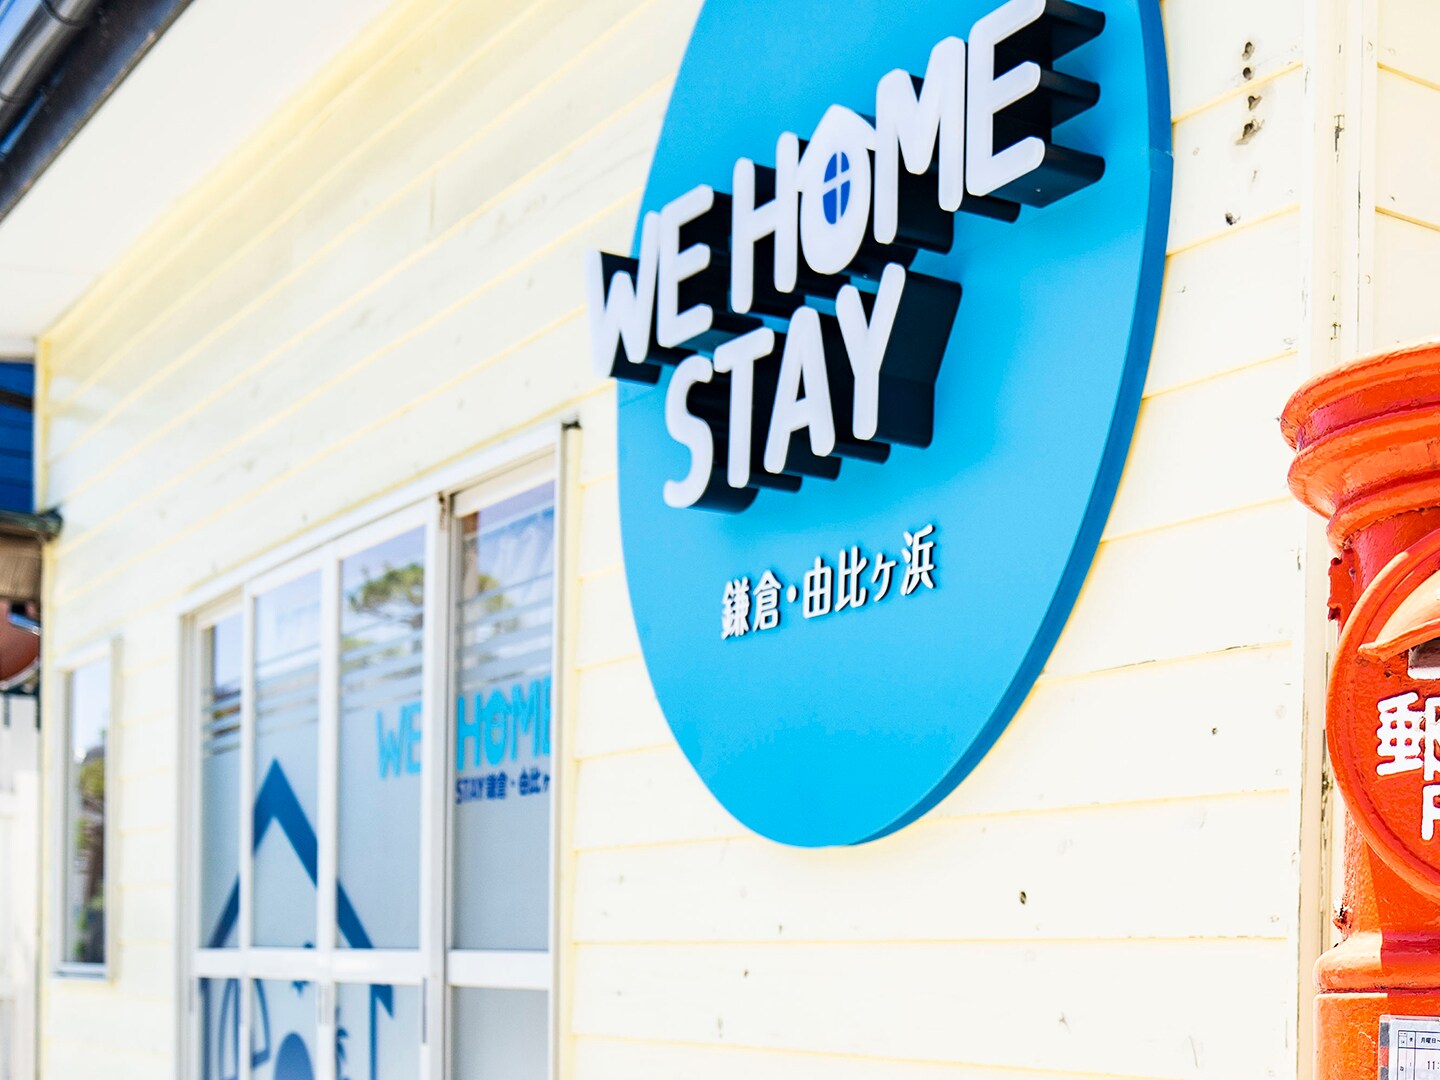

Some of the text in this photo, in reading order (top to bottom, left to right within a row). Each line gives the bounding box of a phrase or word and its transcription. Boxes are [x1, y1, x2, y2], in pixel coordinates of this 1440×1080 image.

[586, 0, 1047, 377] WE HOME
[663, 263, 906, 509] STAY
[375, 700, 422, 779] WE
